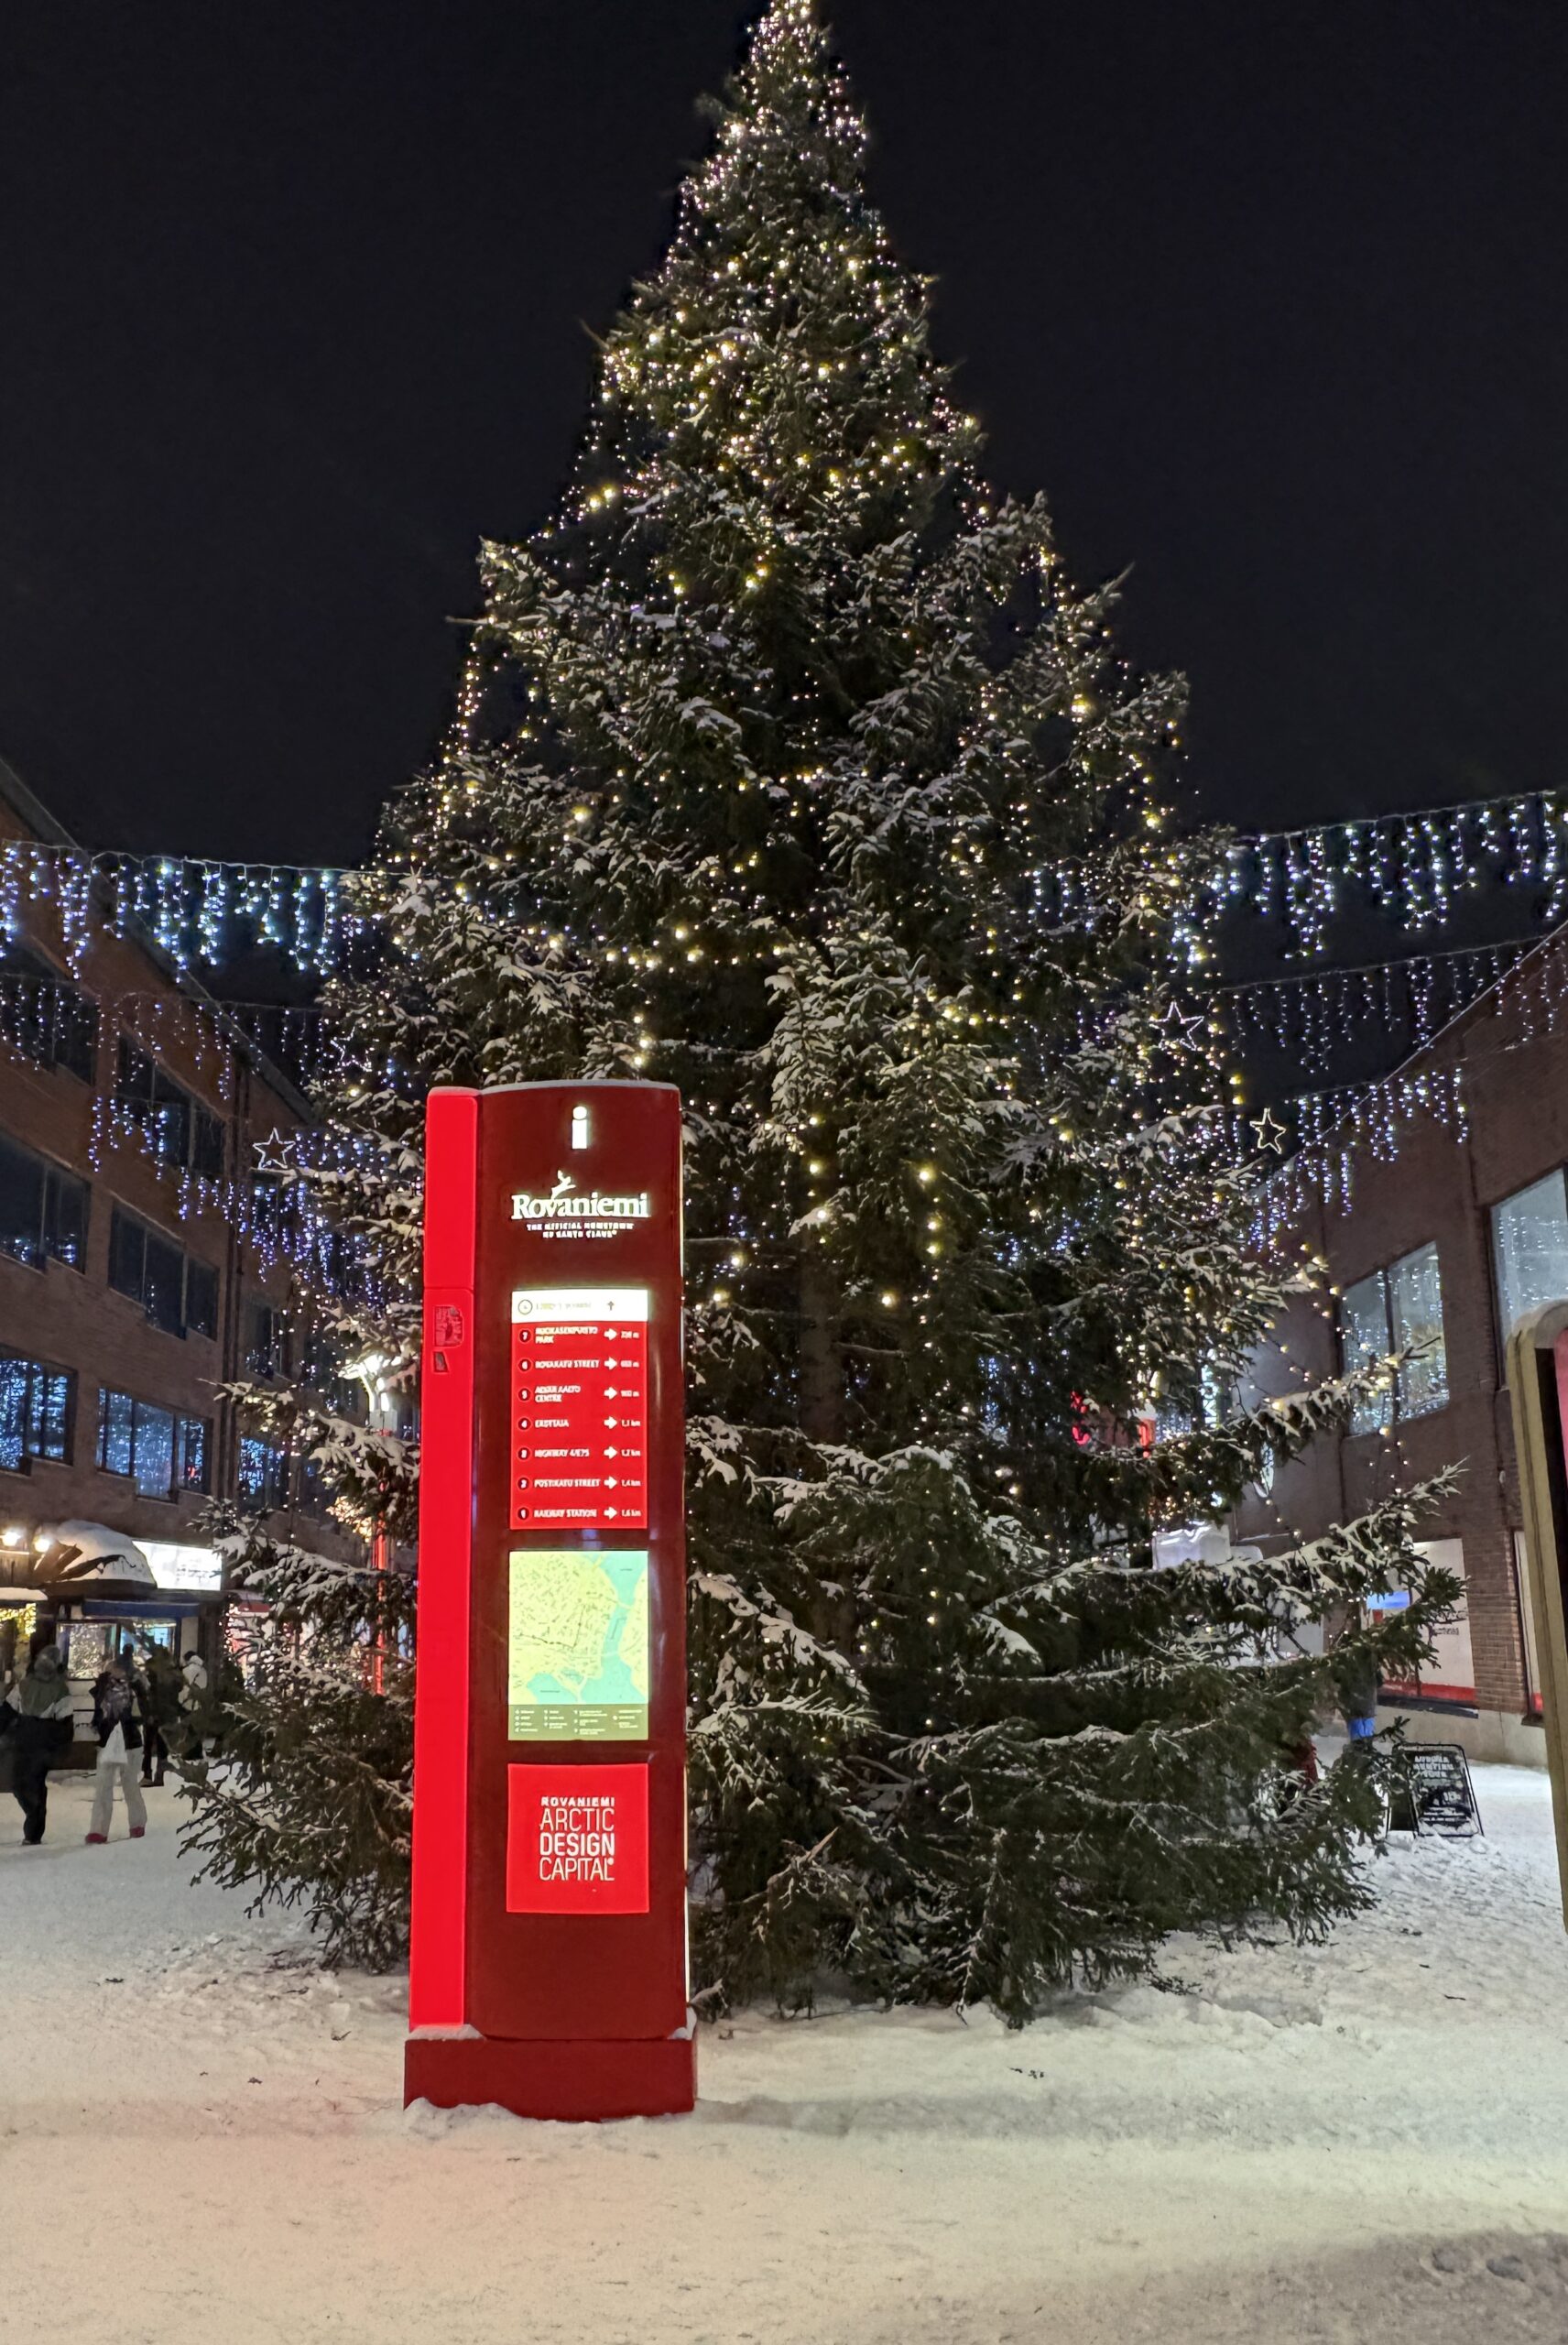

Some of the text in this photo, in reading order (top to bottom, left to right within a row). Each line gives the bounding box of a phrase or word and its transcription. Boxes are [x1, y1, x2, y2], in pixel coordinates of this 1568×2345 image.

[511, 1192, 651, 1219] Rovaniemi
[584, 1222, 634, 1230] HOMETOWN
[556, 1230, 583, 1238] SANTA
[535, 1336, 554, 1344] PARK
[574, 1359, 600, 1368] STREET
[534, 1449, 568, 1457] HIGHWAY
[574, 1478, 601, 1487] STREET
[534, 1510, 565, 1518] RAILWAY
[566, 1509, 597, 1517] STATION
[540, 1796, 615, 1806] ROVANIEMI
[539, 1807, 615, 1832] ARCTIC
[539, 1832, 615, 1857] DESIGN
[539, 1857, 615, 1881] CAPITAL
